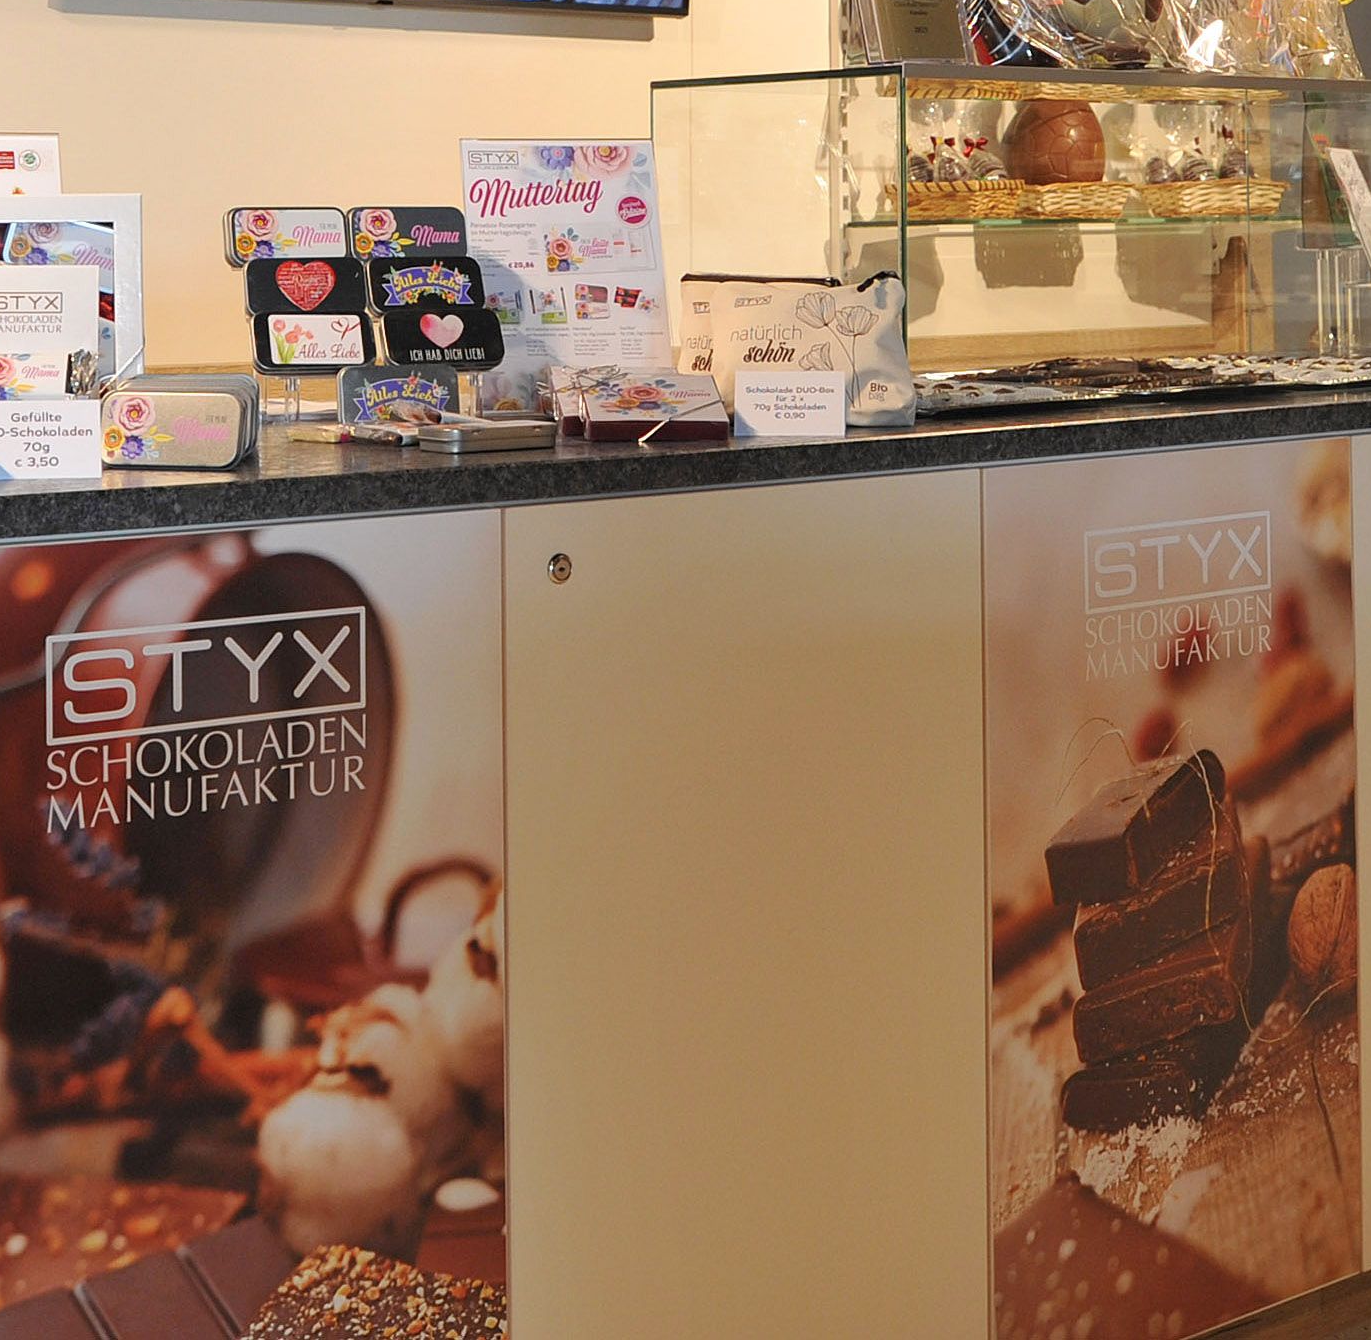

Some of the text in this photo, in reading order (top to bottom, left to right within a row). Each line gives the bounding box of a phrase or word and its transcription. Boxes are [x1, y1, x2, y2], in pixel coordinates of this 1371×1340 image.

[470, 153, 517, 163] STYX
[469, 177, 605, 218] Muttertag
[292, 226, 342, 248] Mama
[410, 224, 461, 248] Mama
[394, 272, 461, 293] Alles Liebe
[686, 334, 712, 350] natür
[729, 323, 803, 342] natürlich
[294, 343, 361, 360] Alles Liebe
[410, 349, 424, 362] ICH
[425, 348, 442, 361] HAB
[443, 348, 463, 361] DICH
[691, 349, 712, 373] sch
[743, 339, 796, 364] schön
[21, 365, 60, 380] Mama
[366, 383, 438, 407] Alles Liebe
[745, 385, 835, 394] Schokolade DUO-Box
[775, 394, 788, 403] für
[753, 402, 827, 412] 70g Schokoladen
[774, 412, 806, 421] € 0,90
[10, 412, 62, 423] Gefüllte
[23, 441, 51, 454] 70g
[27, 456, 60, 468] 3,50
[1094, 525, 1263, 599] STYX
[1085, 593, 1273, 649] SCHOKOLADEN
[1085, 624, 1273, 683] MANUFAKTUR
[62, 624, 352, 725] STYX
[46, 713, 368, 792] SCHOKOLADEN
[46, 755, 367, 835] MANUFAKTUR
